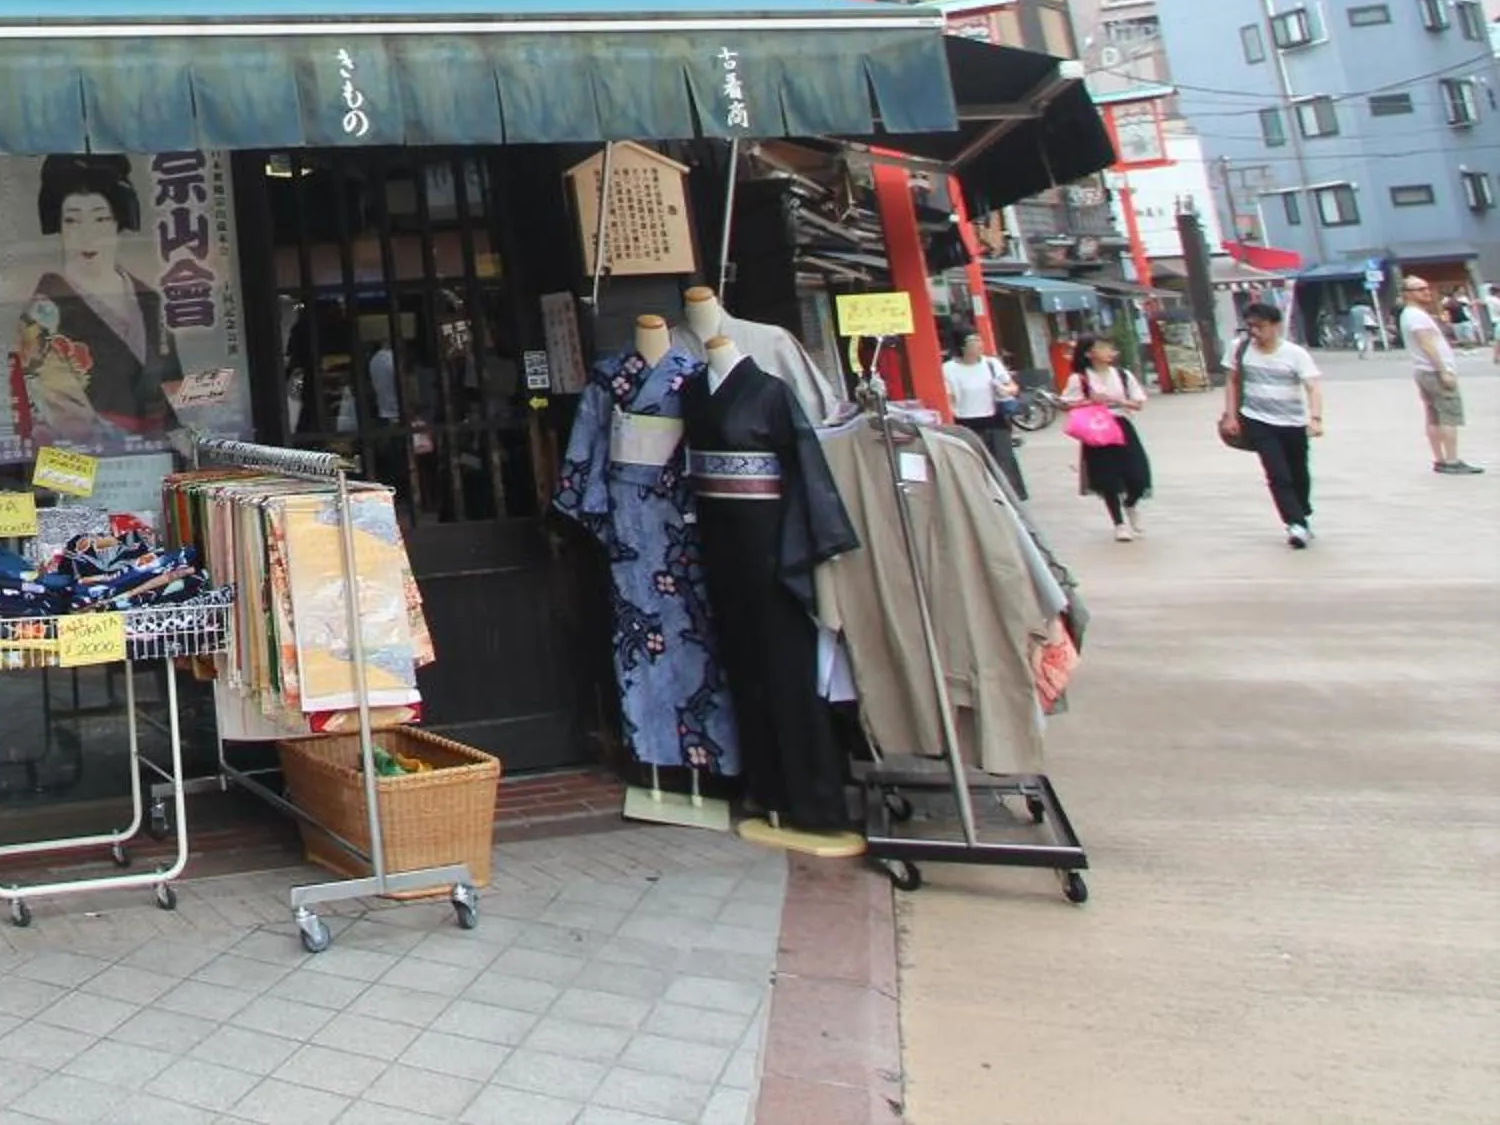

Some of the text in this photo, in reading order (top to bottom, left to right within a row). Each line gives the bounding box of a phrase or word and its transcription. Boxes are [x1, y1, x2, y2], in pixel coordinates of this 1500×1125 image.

[336, 47, 369, 138] きもの
[716, 46, 749, 128] 古着商
